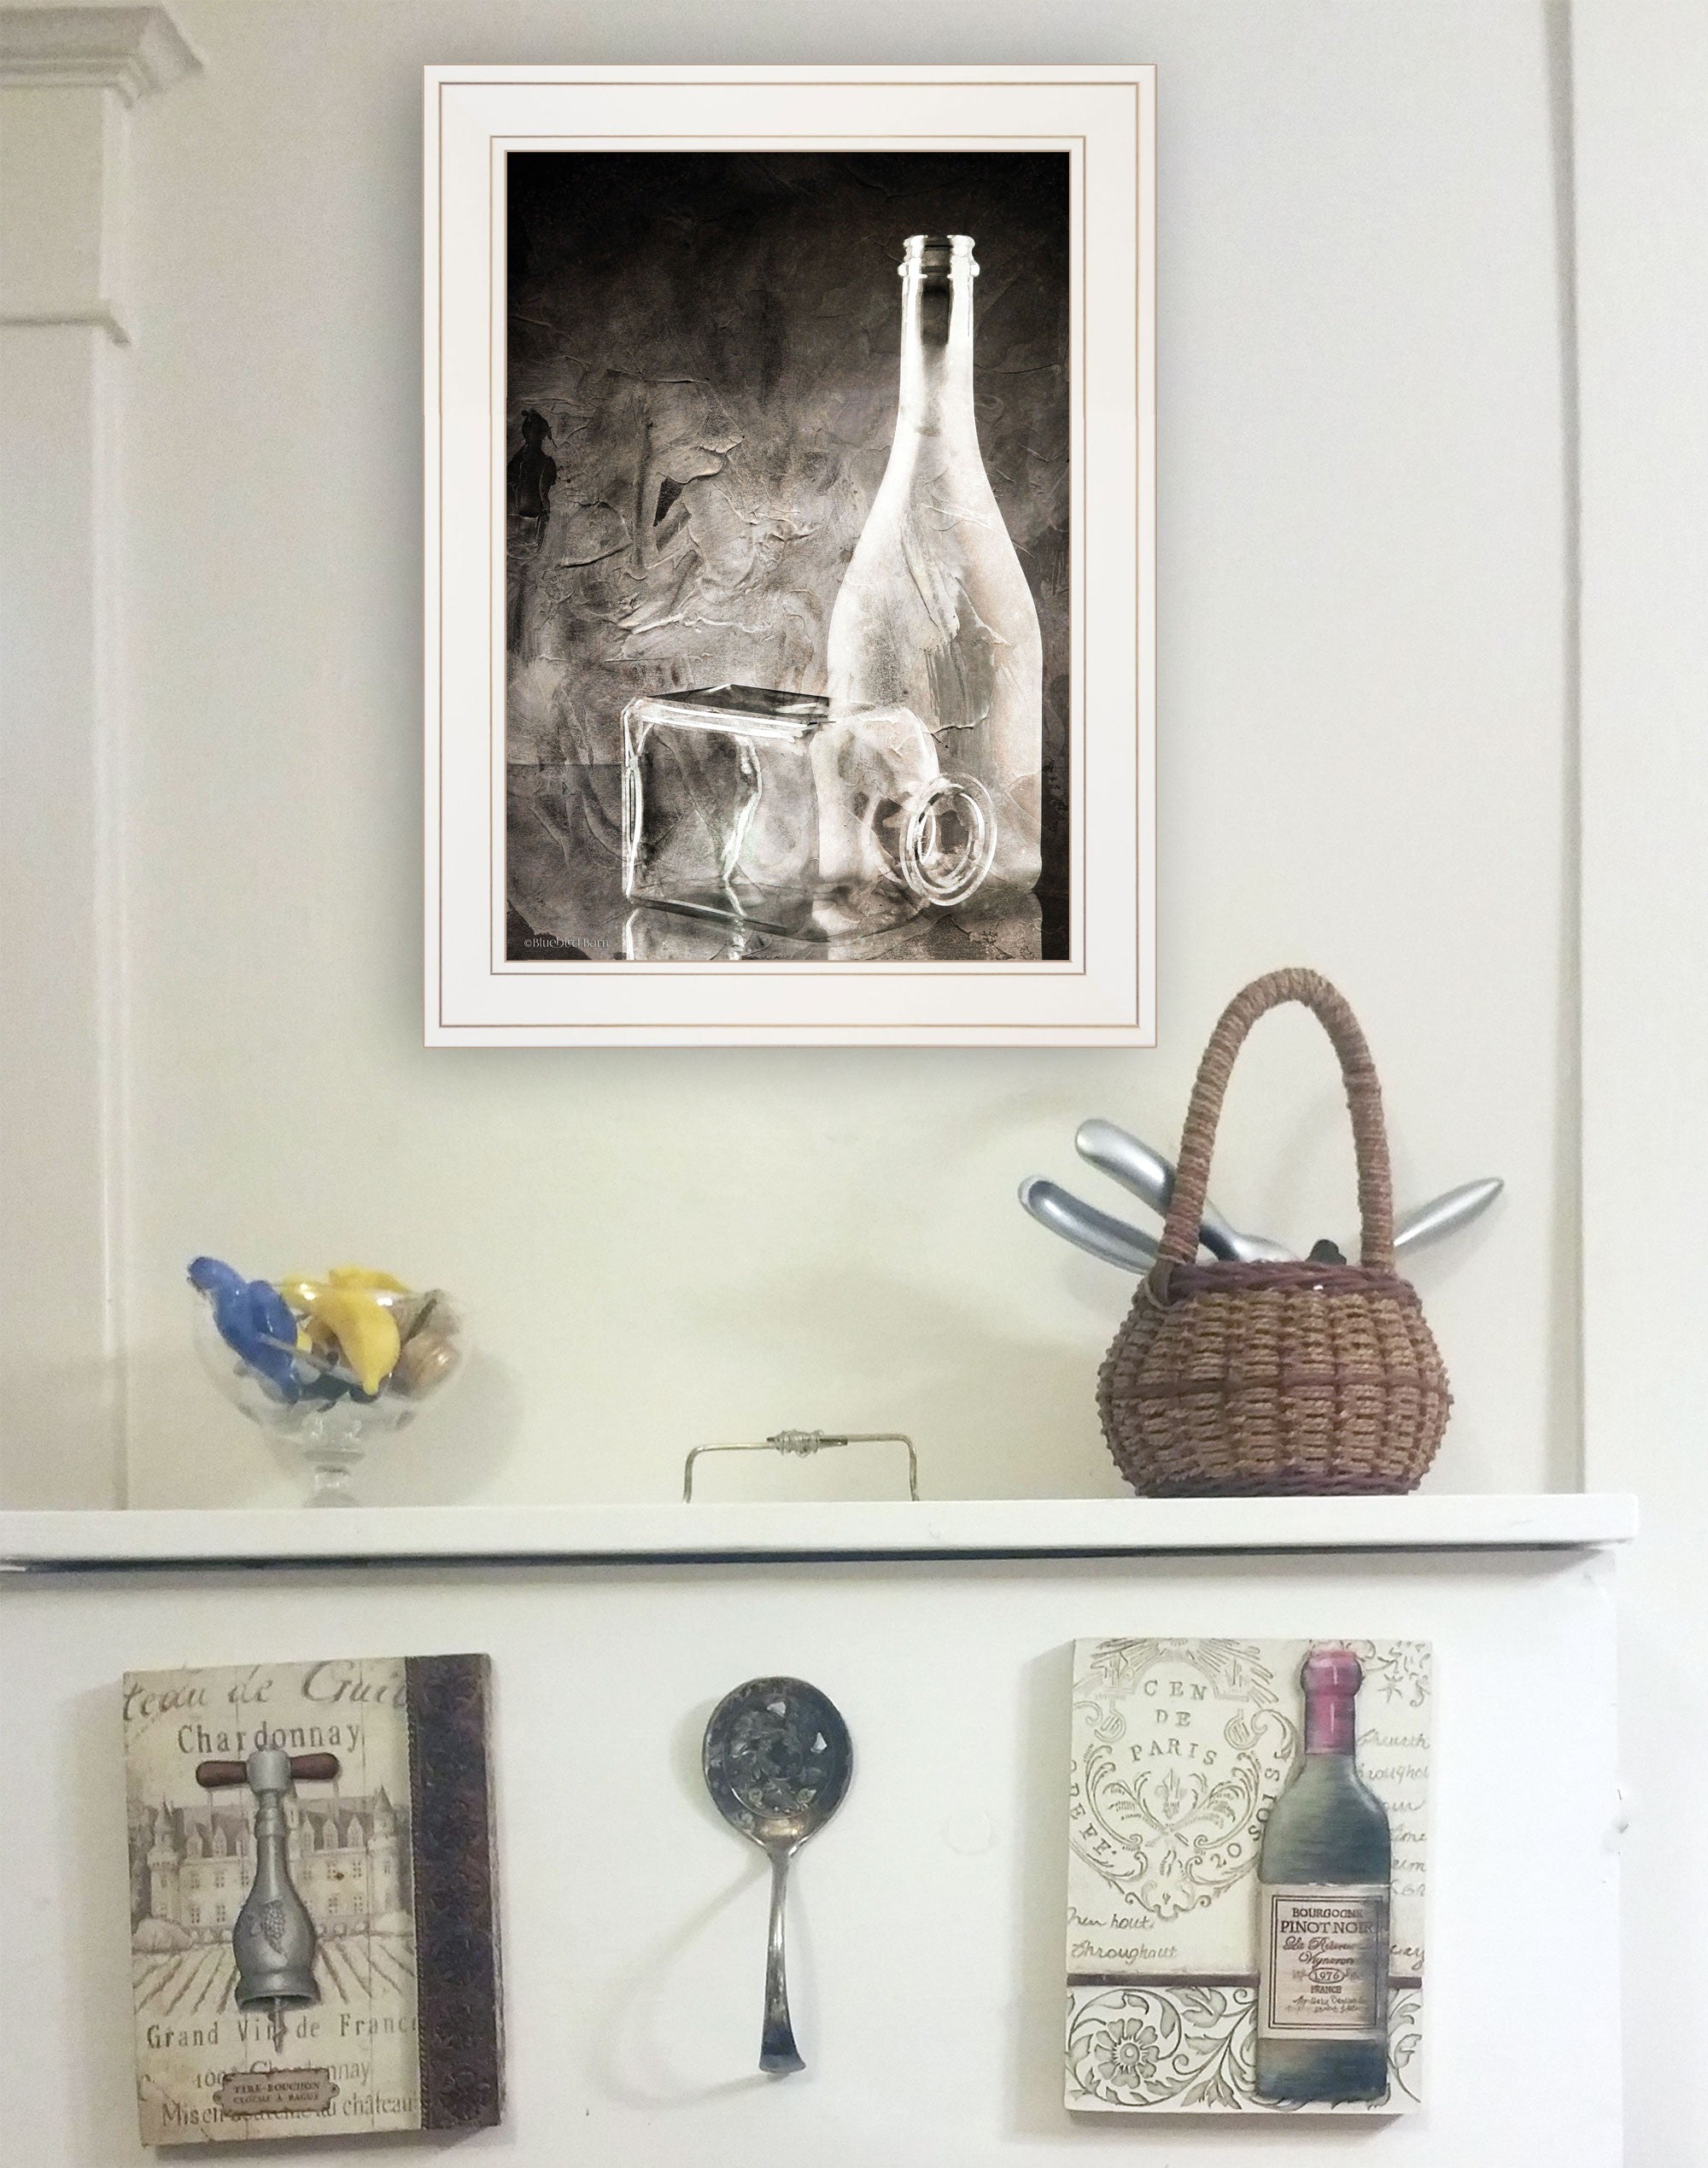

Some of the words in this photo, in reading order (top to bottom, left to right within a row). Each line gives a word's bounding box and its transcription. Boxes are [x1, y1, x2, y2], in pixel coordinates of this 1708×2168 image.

[583, 938, 610, 948] Barn
[227, 1663, 274, 1705] de
[1144, 1679, 1208, 1701] CEN
[1155, 1708, 1191, 1727] DE
[177, 1721, 360, 1754] Chardonnay
[1129, 1737, 1218, 1766] PARIS
[1280, 1920, 1331, 1934] PINOT
[1333, 1921, 1374, 1935] NOIR
[1314, 1970, 1341, 1981] 1976
[1310, 1984, 1342, 1994] FRANCE
[146, 2020, 219, 2049] Grand
[295, 2015, 321, 2040] de
[342, 2091, 413, 2116] château
